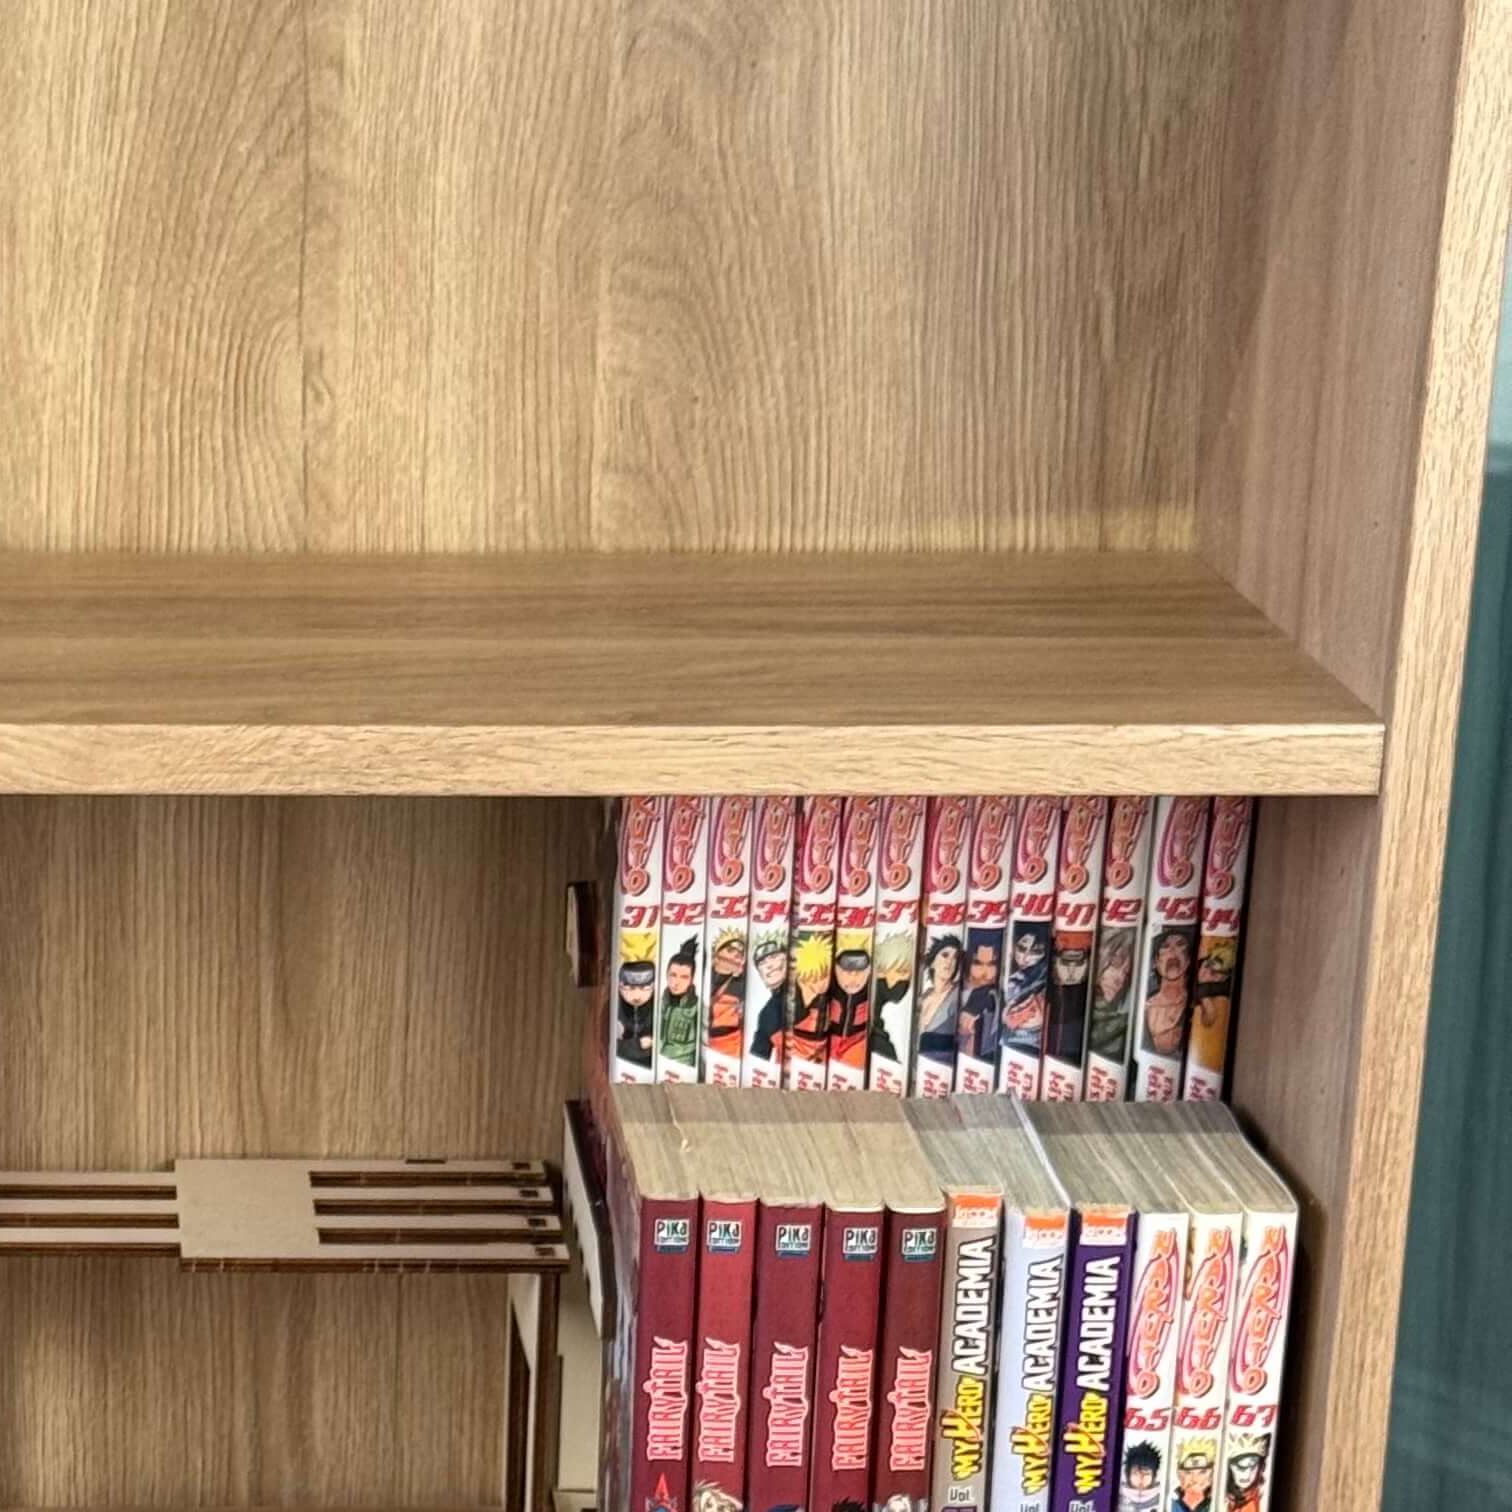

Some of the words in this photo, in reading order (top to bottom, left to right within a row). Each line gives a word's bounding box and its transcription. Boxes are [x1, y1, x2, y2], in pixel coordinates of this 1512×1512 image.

[621, 905, 660, 928] 31
[663, 903, 705, 925] 32
[1012, 893, 1054, 916] 40
[1157, 897, 1198, 919] 43
[952, 1238, 993, 1374] ACADEMIA
[1023, 1255, 1062, 1390] ACADEMIA
[1077, 1256, 1120, 1390] ACADEMIA
[643, 1336, 687, 1398] TAIL
[696, 1337, 739, 1399] TAIL
[763, 1342, 808, 1404] TAIL
[829, 1345, 873, 1406] TAIL
[888, 1346, 932, 1407] TAIL
[647, 1398, 687, 1460] FAIRY
[698, 1399, 740, 1462] FAIRY
[767, 1404, 808, 1466] FAIRY
[832, 1406, 871, 1470] FAIRY
[889, 1407, 931, 1471] FAIRY
[1125, 1407, 1170, 1431] 65
[1175, 1406, 1221, 1430] 66
[1231, 1404, 1277, 1426] 67
[951, 1437, 982, 1480] MY
[1022, 1452, 1048, 1495] MY
[1074, 1452, 1103, 1494] MY
